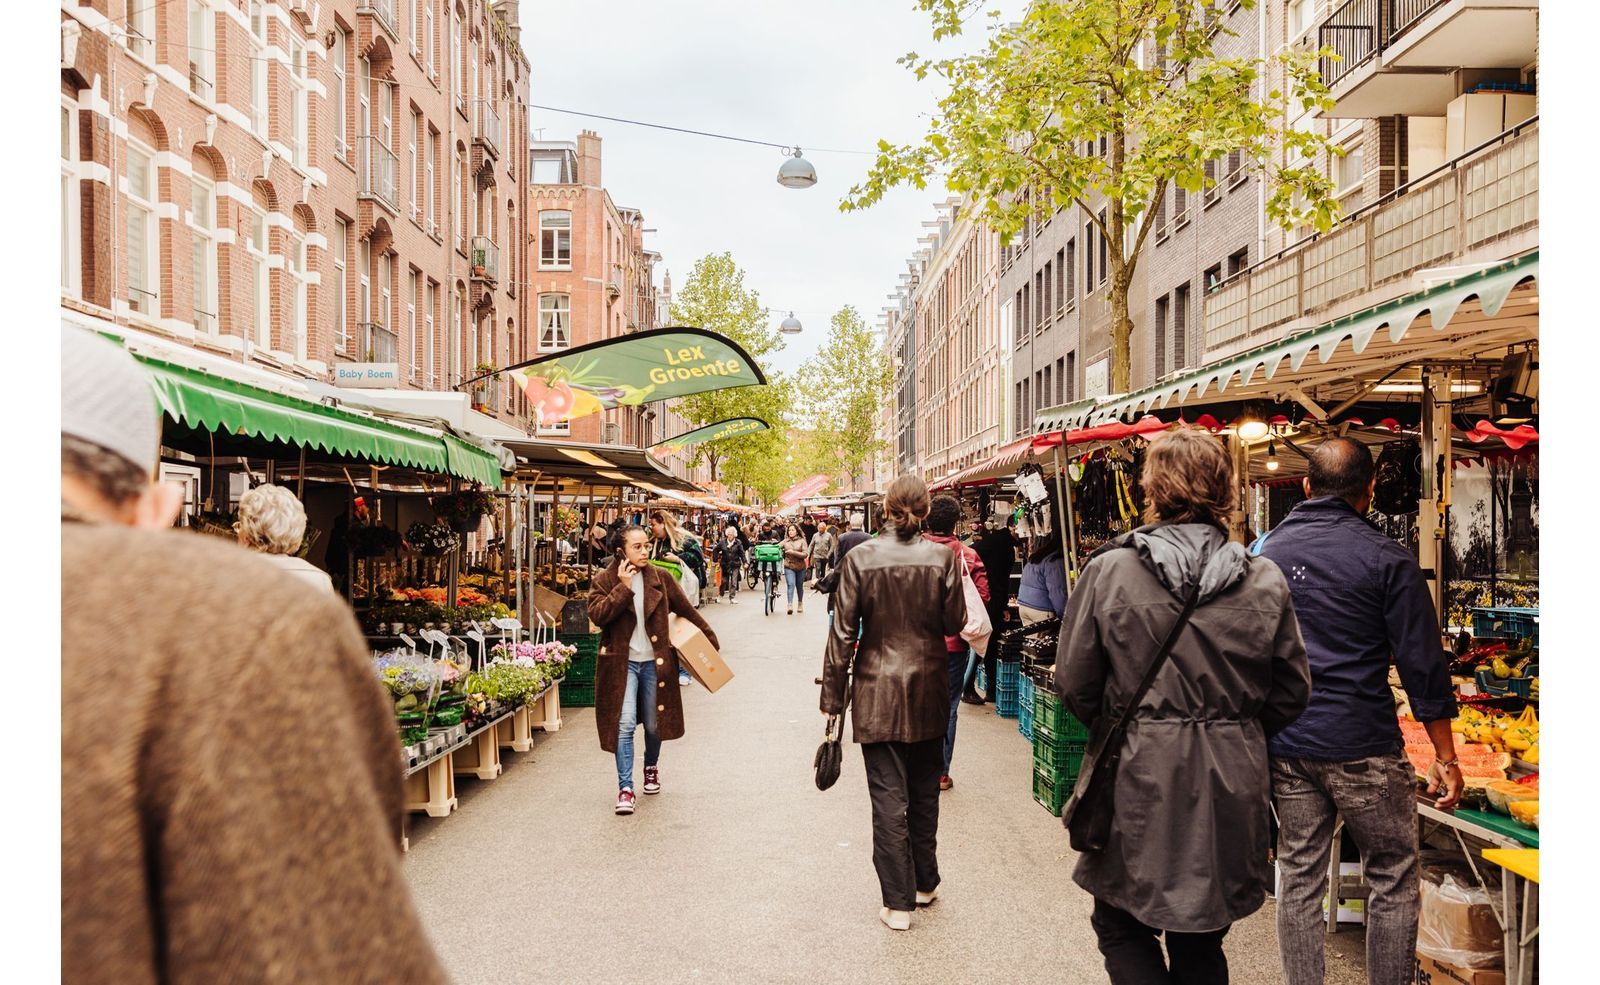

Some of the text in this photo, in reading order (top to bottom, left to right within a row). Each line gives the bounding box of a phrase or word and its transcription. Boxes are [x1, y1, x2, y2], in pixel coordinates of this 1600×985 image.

[664, 345, 706, 365] Lex
[339, 369, 393, 380] Baby Boem
[649, 359, 741, 384] Groente
